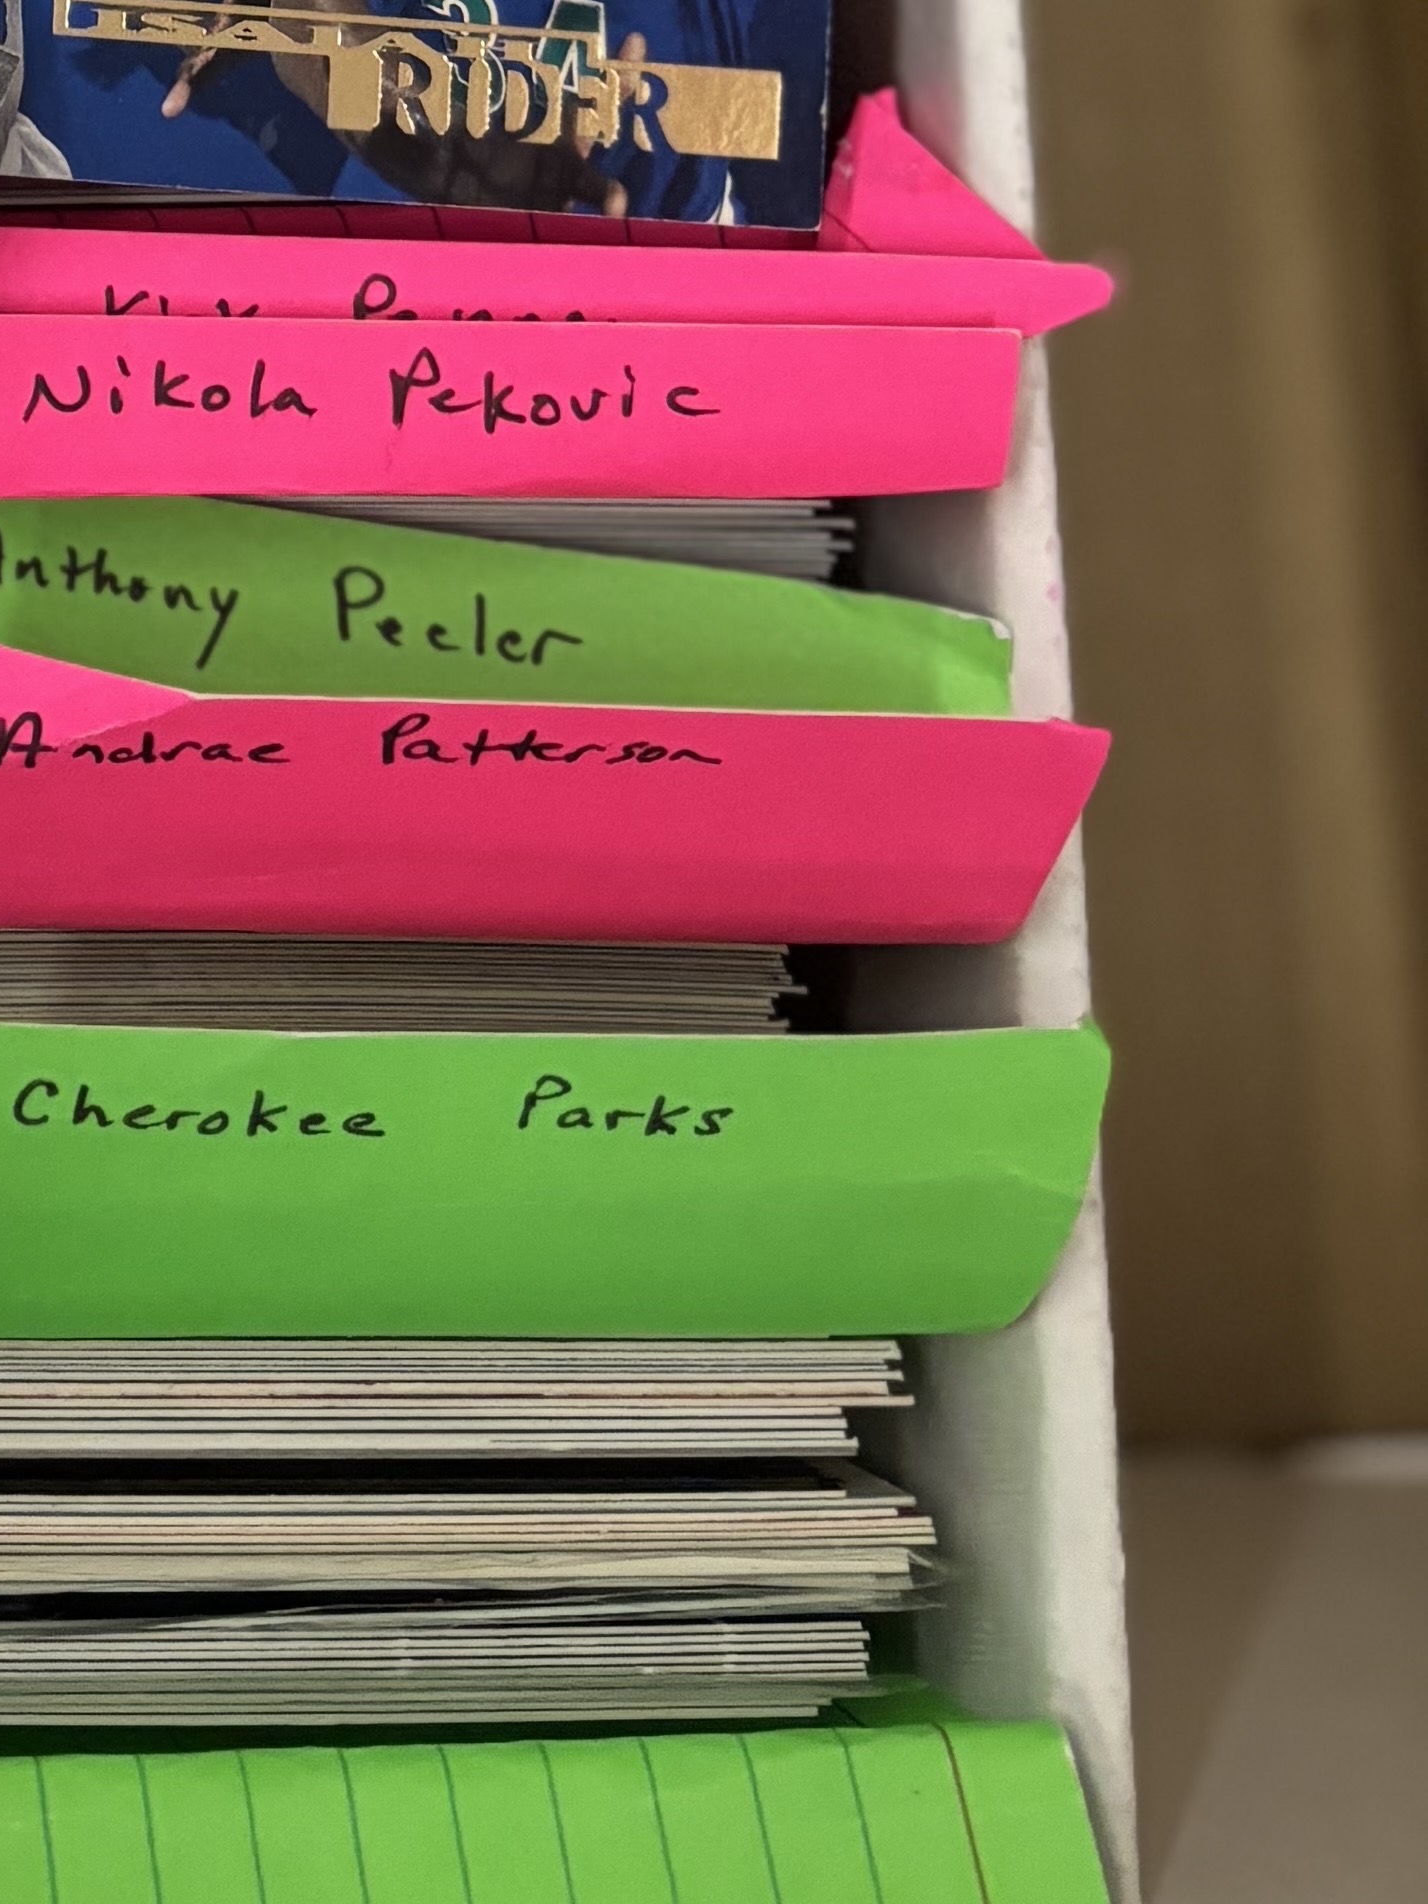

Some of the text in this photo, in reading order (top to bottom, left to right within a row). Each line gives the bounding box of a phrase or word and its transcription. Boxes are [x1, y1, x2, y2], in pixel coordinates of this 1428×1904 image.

[22, 346, 722, 435] Nikola Pekovic
[331, 564, 584, 668] Peeler
[379, 711, 724, 769] Patterson
[12, 1072, 736, 1138] Cherokee Parks
